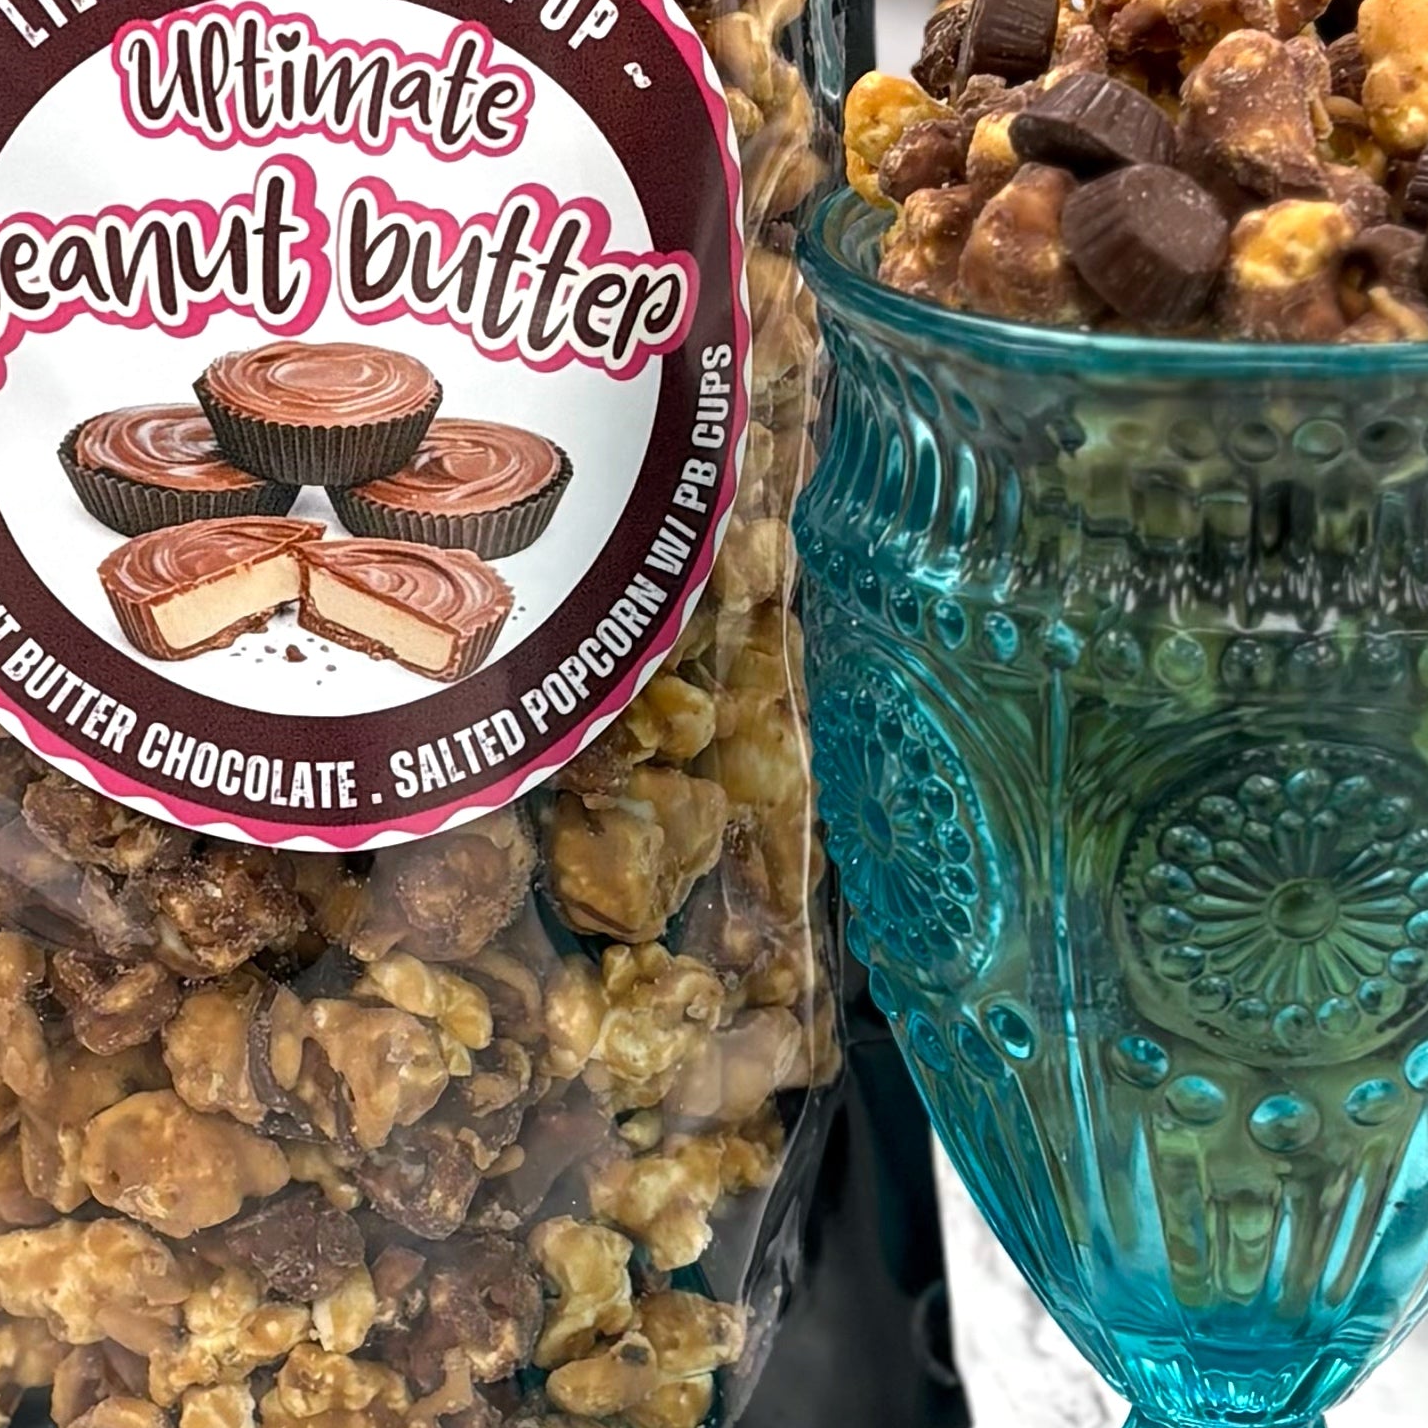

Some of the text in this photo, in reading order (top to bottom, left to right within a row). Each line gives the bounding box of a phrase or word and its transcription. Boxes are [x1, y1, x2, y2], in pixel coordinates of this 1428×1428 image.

[127, 19, 520, 145] Ultimate
[349, 198, 681, 360] butter
[691, 343, 733, 449] CUPS
[673, 457, 718, 515] PB
[646, 514, 697, 577] W/
[2, 637, 136, 754] BUTTER
[520, 572, 668, 734] POPCORN
[137, 721, 357, 810] CHOCOLATE
[390, 709, 525, 799] SALTED
